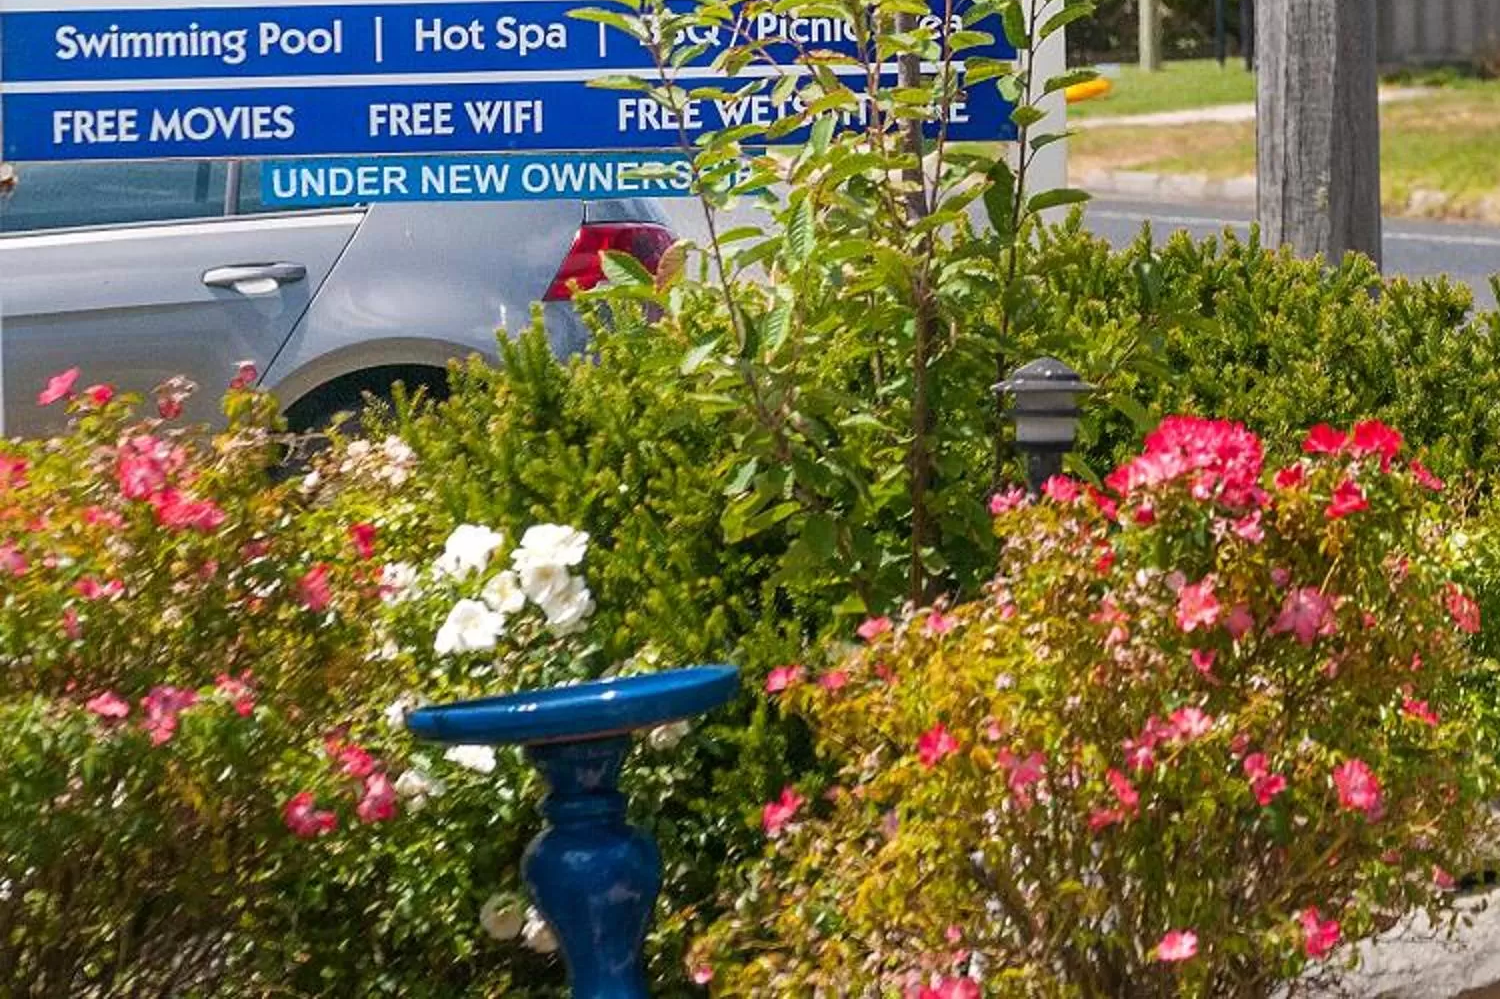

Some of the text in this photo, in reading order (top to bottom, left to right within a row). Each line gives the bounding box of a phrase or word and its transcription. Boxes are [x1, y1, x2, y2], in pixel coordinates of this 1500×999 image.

[56, 23, 247, 65] Swimming
[259, 19, 342, 55] Pool
[415, 17, 485, 52] Hot
[496, 16, 567, 56] Spa
[53, 109, 139, 144] FREE
[150, 105, 295, 142] MOVIES
[370, 102, 455, 136] FREE
[465, 99, 543, 134] WIFI
[618, 97, 704, 131] FREE
[273, 165, 408, 199] UNDER
[421, 163, 510, 194] NEW
